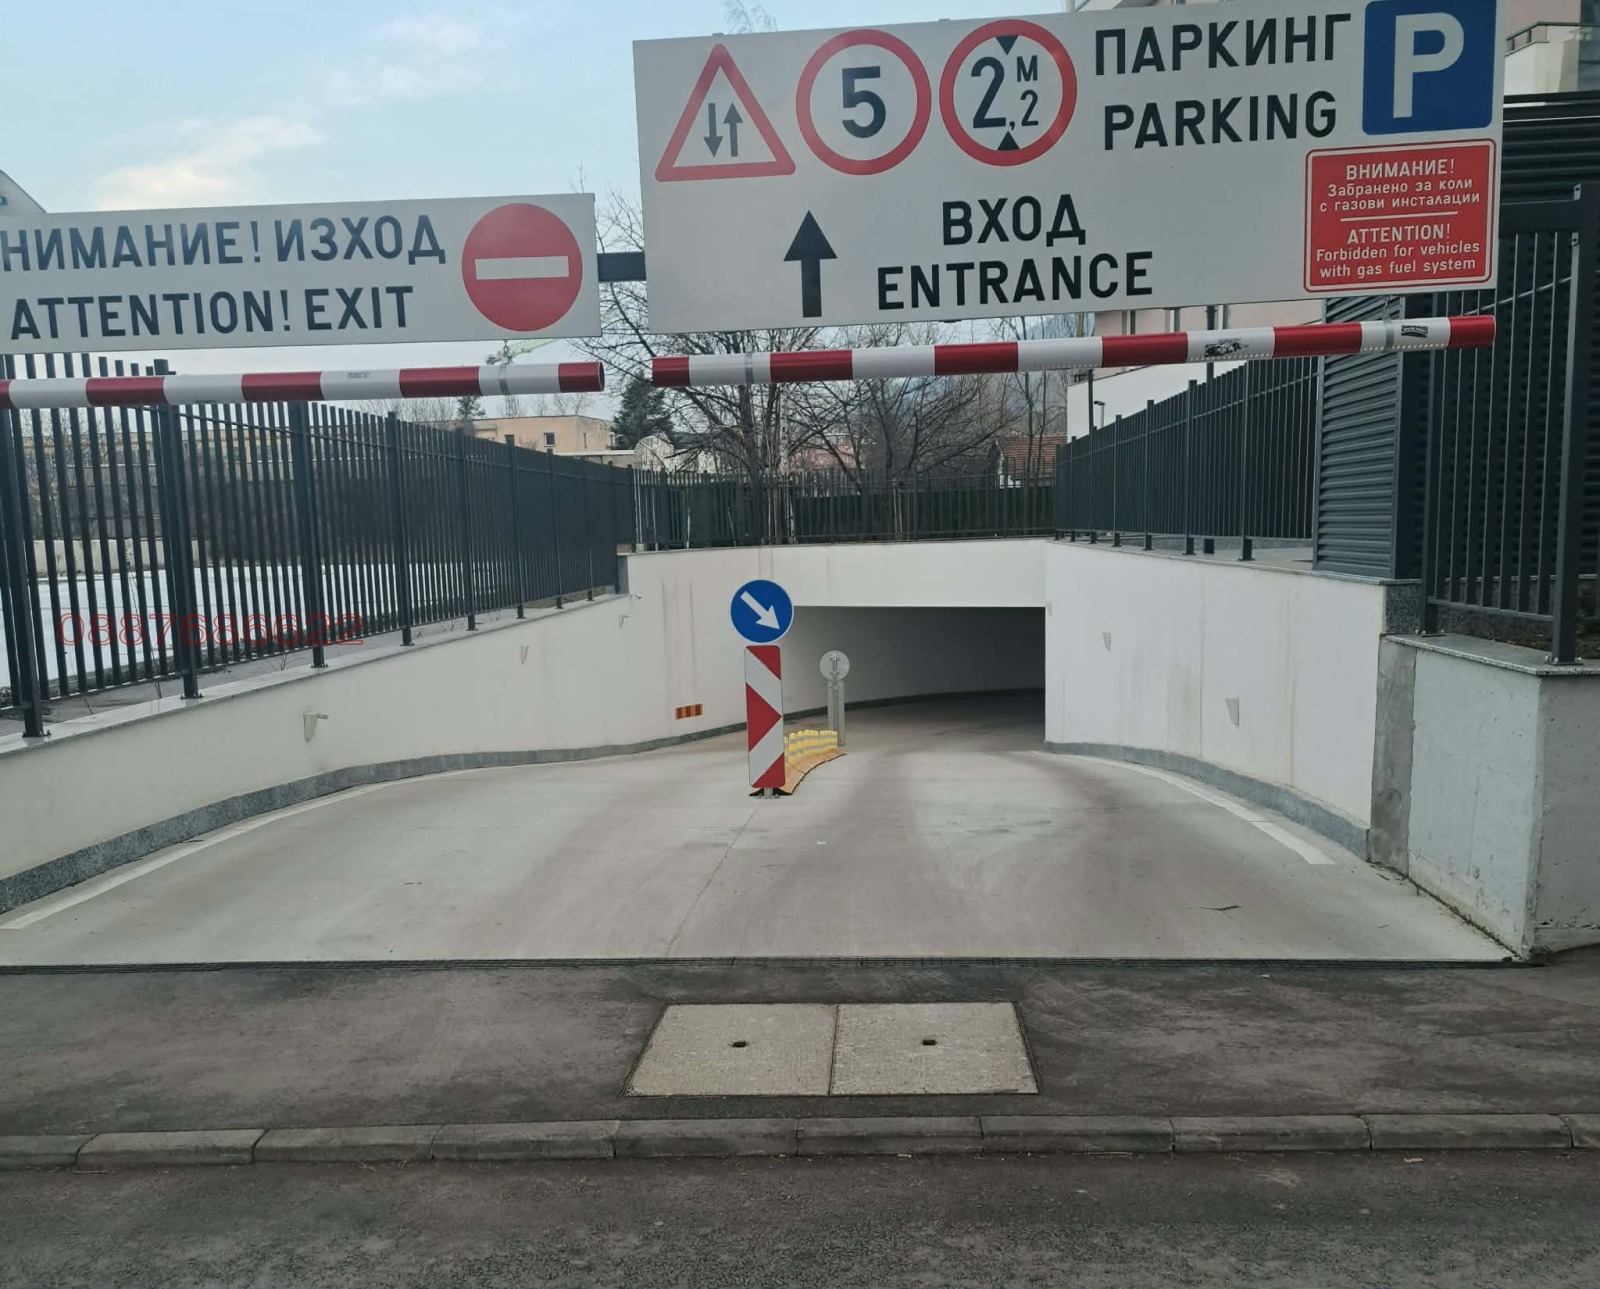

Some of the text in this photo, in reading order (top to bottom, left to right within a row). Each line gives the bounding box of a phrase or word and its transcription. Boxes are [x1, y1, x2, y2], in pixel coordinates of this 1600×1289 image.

[1095, 12, 1352, 76] ПАРКИНГ
[1393, 12, 1465, 119] P
[842, 66, 887, 139] 5
[1104, 90, 1337, 151] PARKING
[1327, 178, 1473, 200] Забранено за коли
[1347, 158, 1455, 181] ВНИМАНИЕ!
[942, 193, 1087, 248] ВХОД
[1319, 193, 1480, 213] с газови инсталации
[274, 215, 446, 266] ИЗХОД
[1316, 241, 1480, 262] Forbidden for vehicles
[1347, 223, 1451, 245] ATTENTION!
[877, 250, 1153, 311] ENTRANCE
[1320, 259, 1476, 279] with gas fuel system
[10, 285, 414, 341] ATTENTION! EXIT
